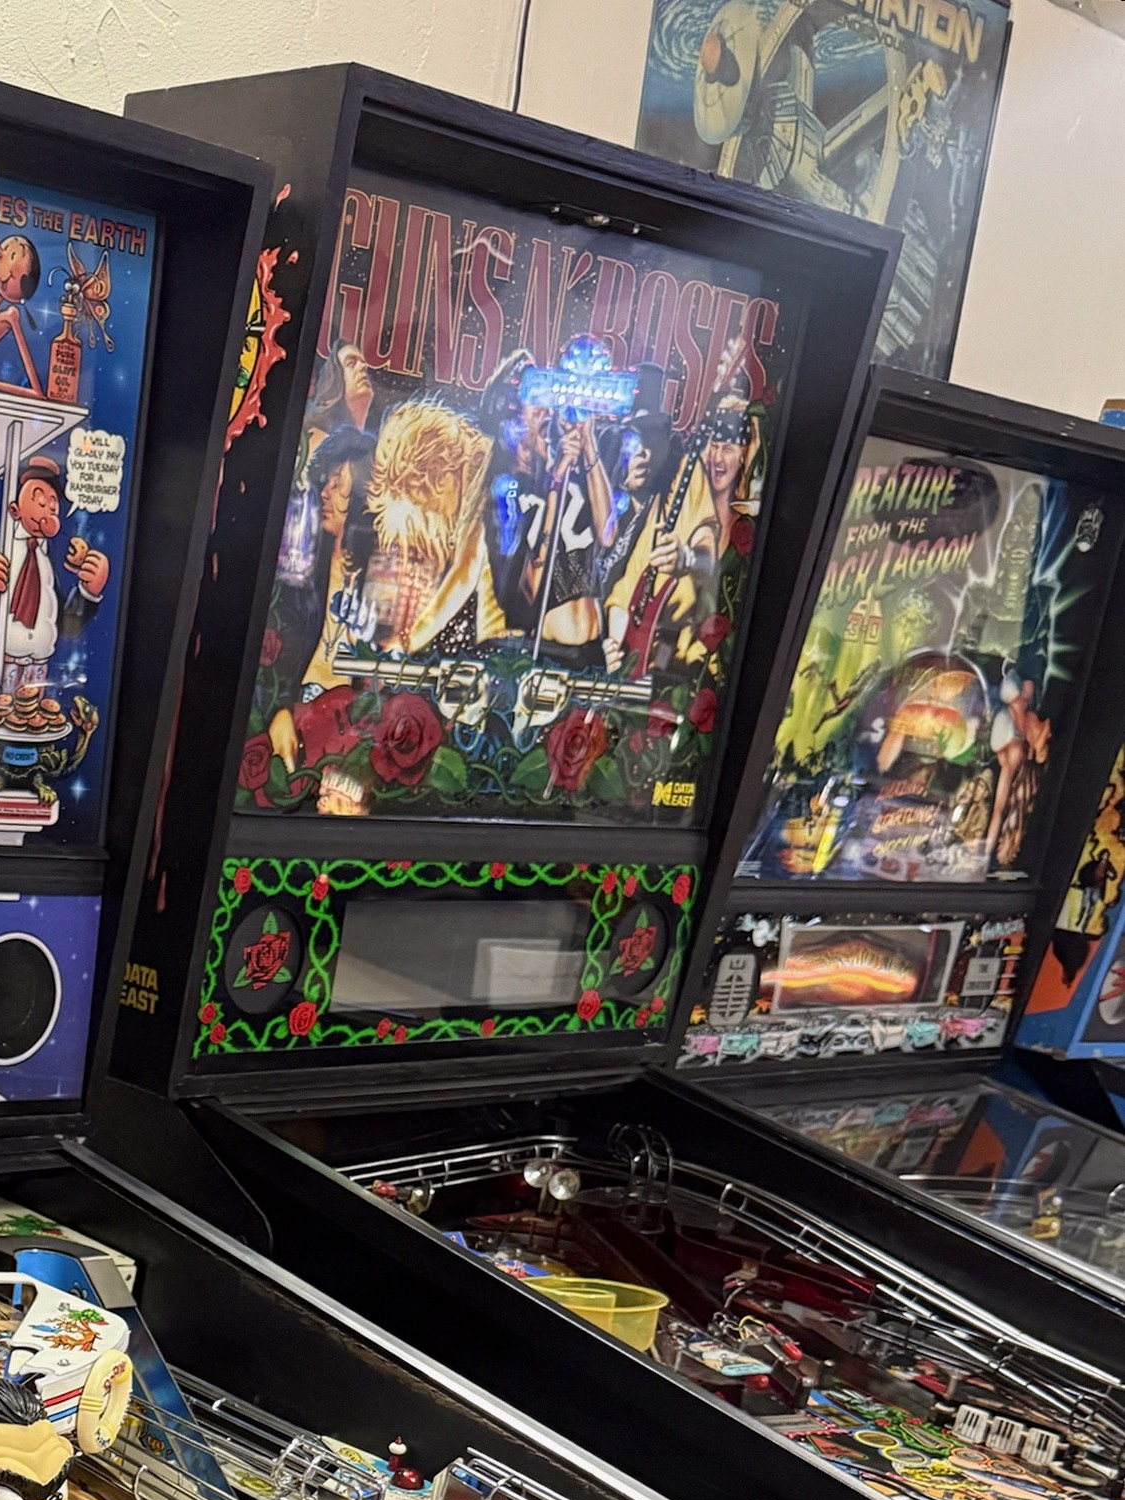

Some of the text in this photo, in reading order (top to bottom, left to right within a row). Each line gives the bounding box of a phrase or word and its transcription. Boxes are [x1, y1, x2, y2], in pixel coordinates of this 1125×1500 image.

[31, 206, 64, 233] THE
[68, 212, 147, 257] EARTH
[315, 188, 516, 391] GUNS
[587, 255, 780, 433] ROSES
[90, 437, 110, 447] WILL
[106, 450, 121, 460] PAY
[70, 459, 120, 475] YOU TUESDAY
[79, 471, 104, 482] FOR A
[69, 482, 118, 495] HAMBURGER
[845, 465, 962, 520] REATURE
[845, 517, 928, 554] FROM THE
[819, 532, 978, 610] ACK LAGOON
[671, 795, 694, 807] EAST
